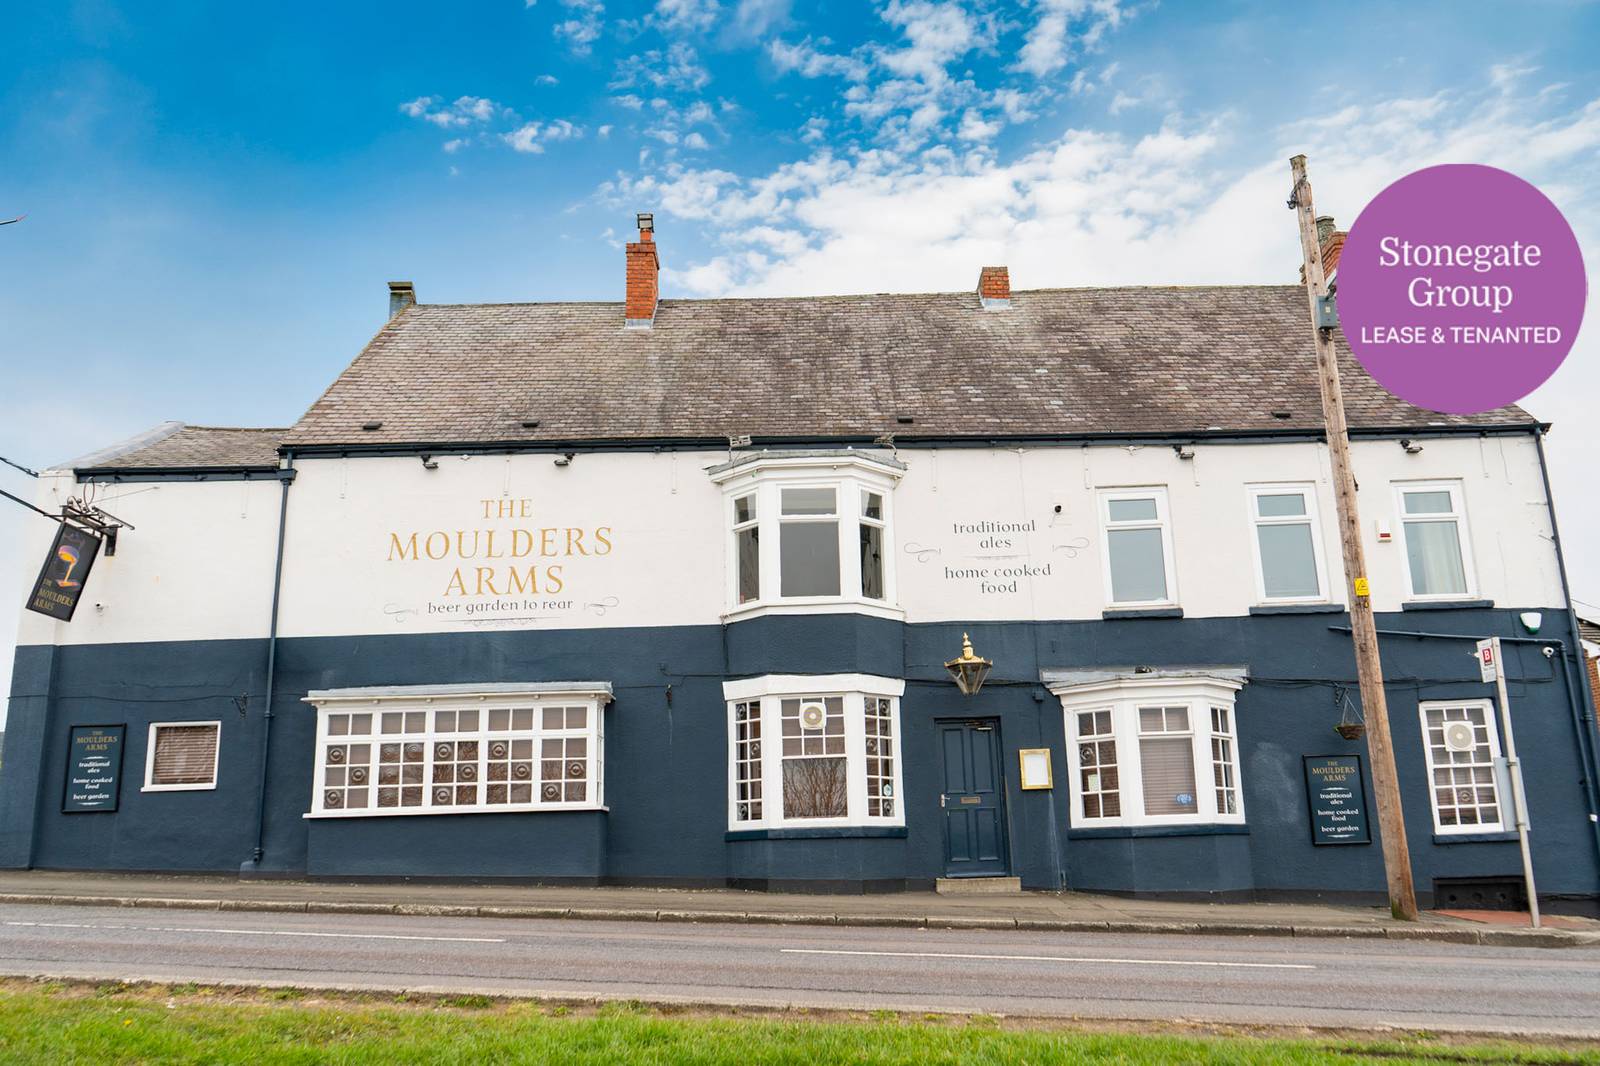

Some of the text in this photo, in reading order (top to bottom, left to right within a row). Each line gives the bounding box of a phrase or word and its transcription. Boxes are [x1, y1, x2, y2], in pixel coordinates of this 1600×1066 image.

[480, 499, 533, 519] THE
[953, 520, 1036, 534] traditional
[387, 527, 612, 561] MOULDERS
[980, 537, 1012, 549] ales
[945, 564, 1051, 579] home cooked
[442, 565, 563, 597] ARMS
[981, 581, 1017, 593] food
[428, 599, 573, 615] beer garden to rear
[76, 736, 117, 744] MOULDERS
